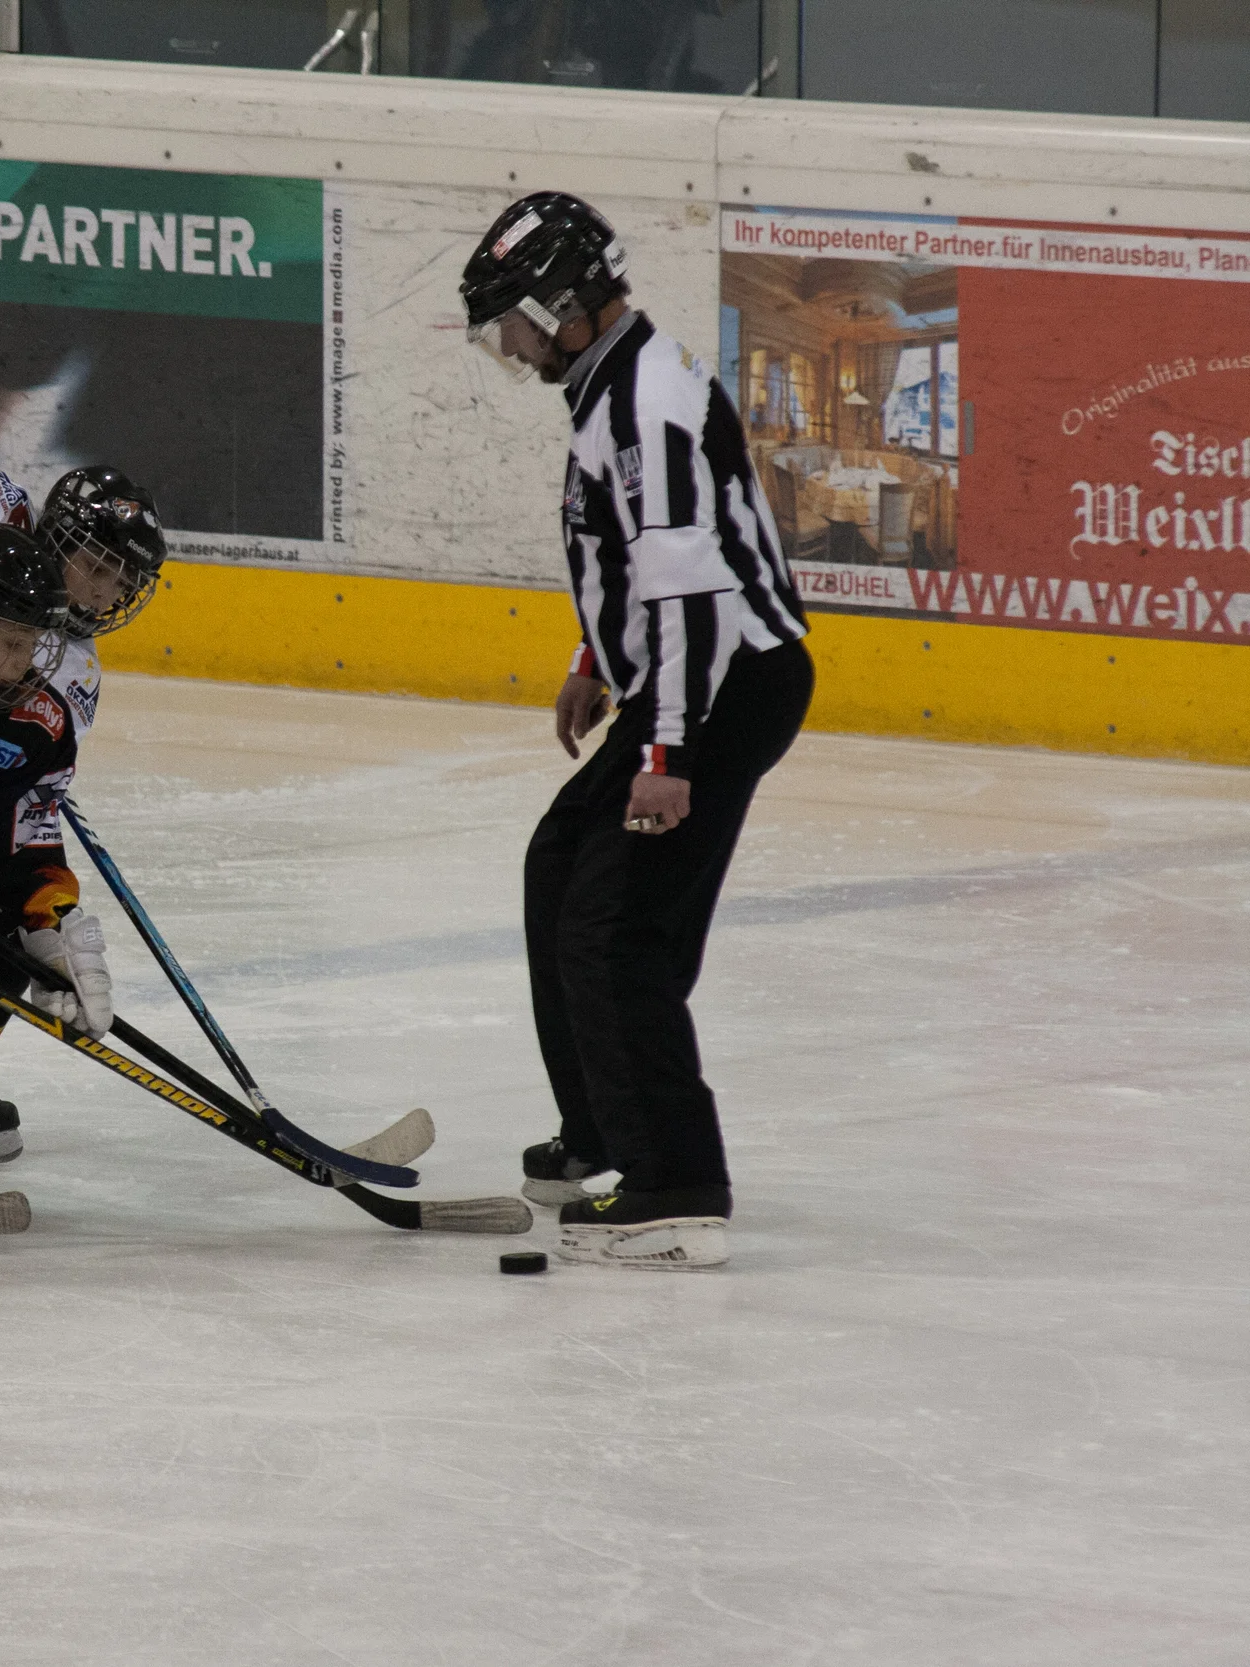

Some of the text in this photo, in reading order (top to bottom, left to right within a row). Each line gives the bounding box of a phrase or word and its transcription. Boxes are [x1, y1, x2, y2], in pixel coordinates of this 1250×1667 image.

[734, 219, 1250, 273] Ihr kompetenter Partner für Innenausbau, Plan
[330, 475, 346, 544] printed
[791, 568, 896, 599] ITZBÜHEL
